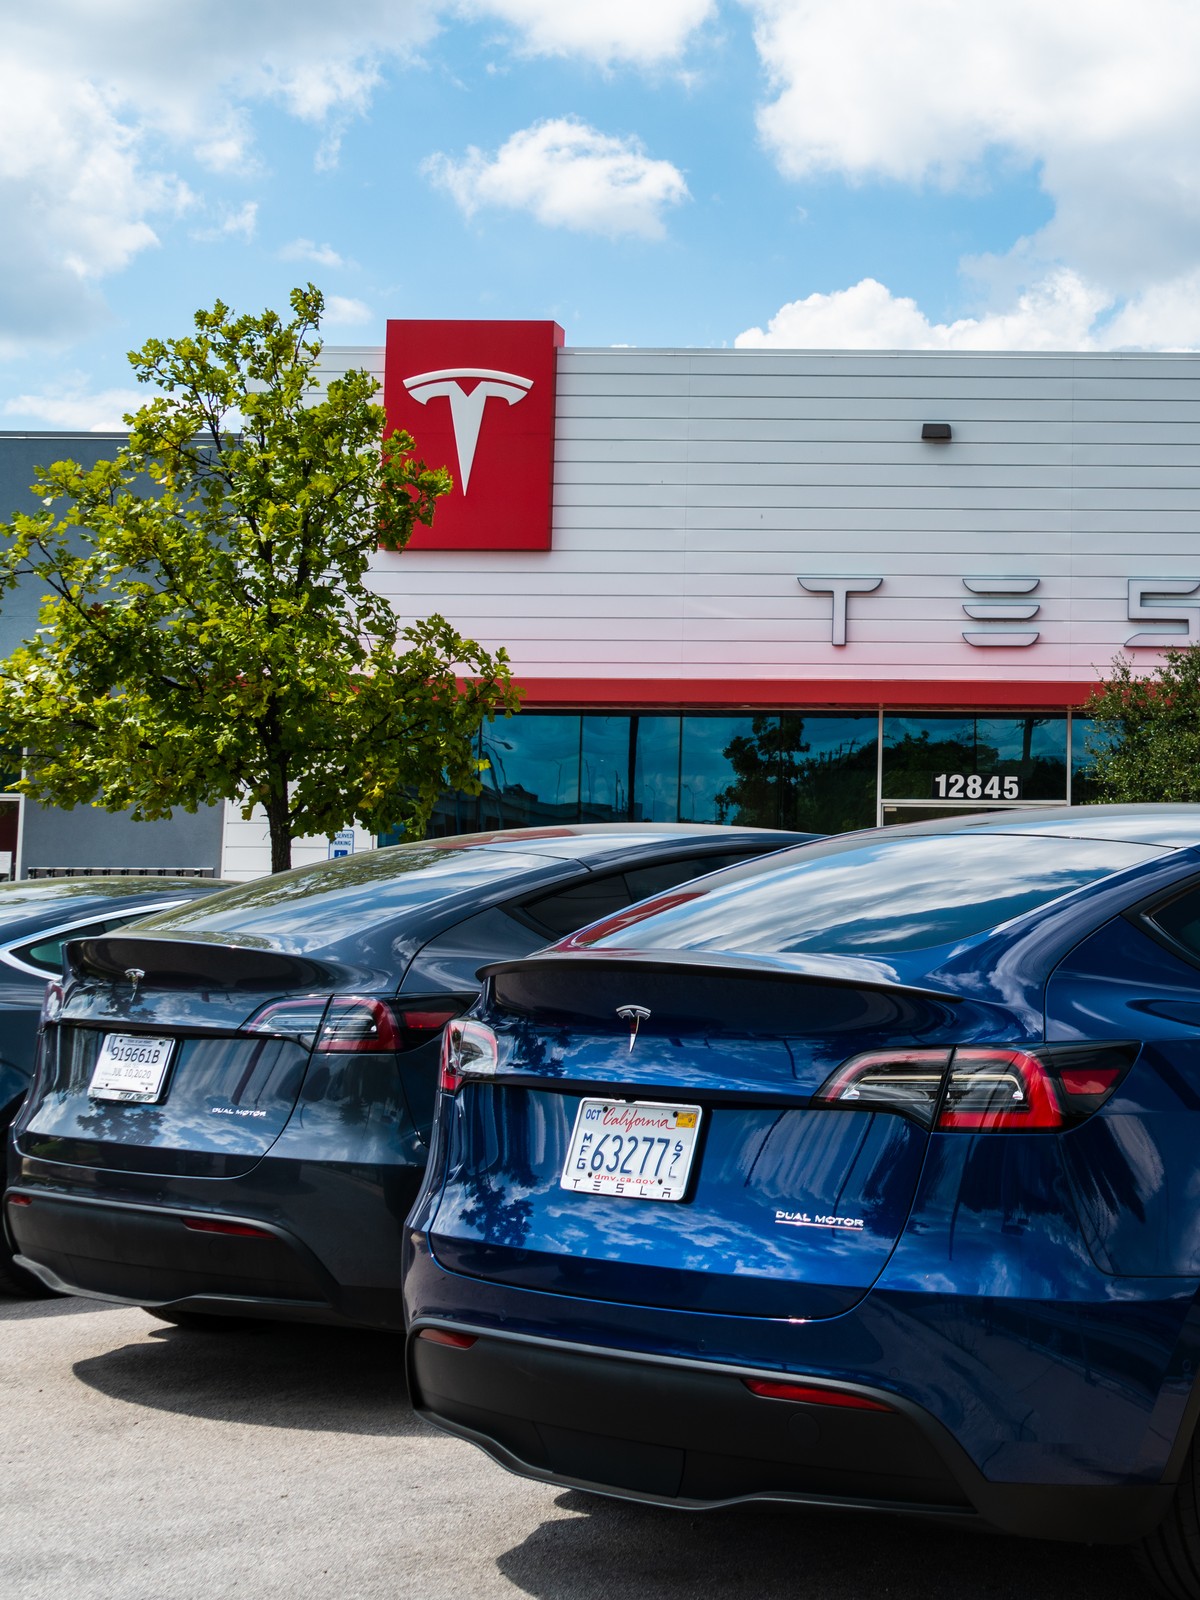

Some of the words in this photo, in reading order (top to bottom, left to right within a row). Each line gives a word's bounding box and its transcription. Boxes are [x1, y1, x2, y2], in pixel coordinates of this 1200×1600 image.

[934, 773, 1019, 799] 12845
[111, 1046, 161, 1064] 919661B
[212, 1107, 234, 1115] DUAL
[236, 1109, 267, 1117] MOTOR
[586, 1108, 601, 1120] OCT
[602, 1107, 675, 1133] California
[590, 1133, 671, 1177] 63277
[573, 1178, 671, 1198] TESLA
[775, 1210, 811, 1221] DUAL
[814, 1214, 864, 1227] MOTOR
